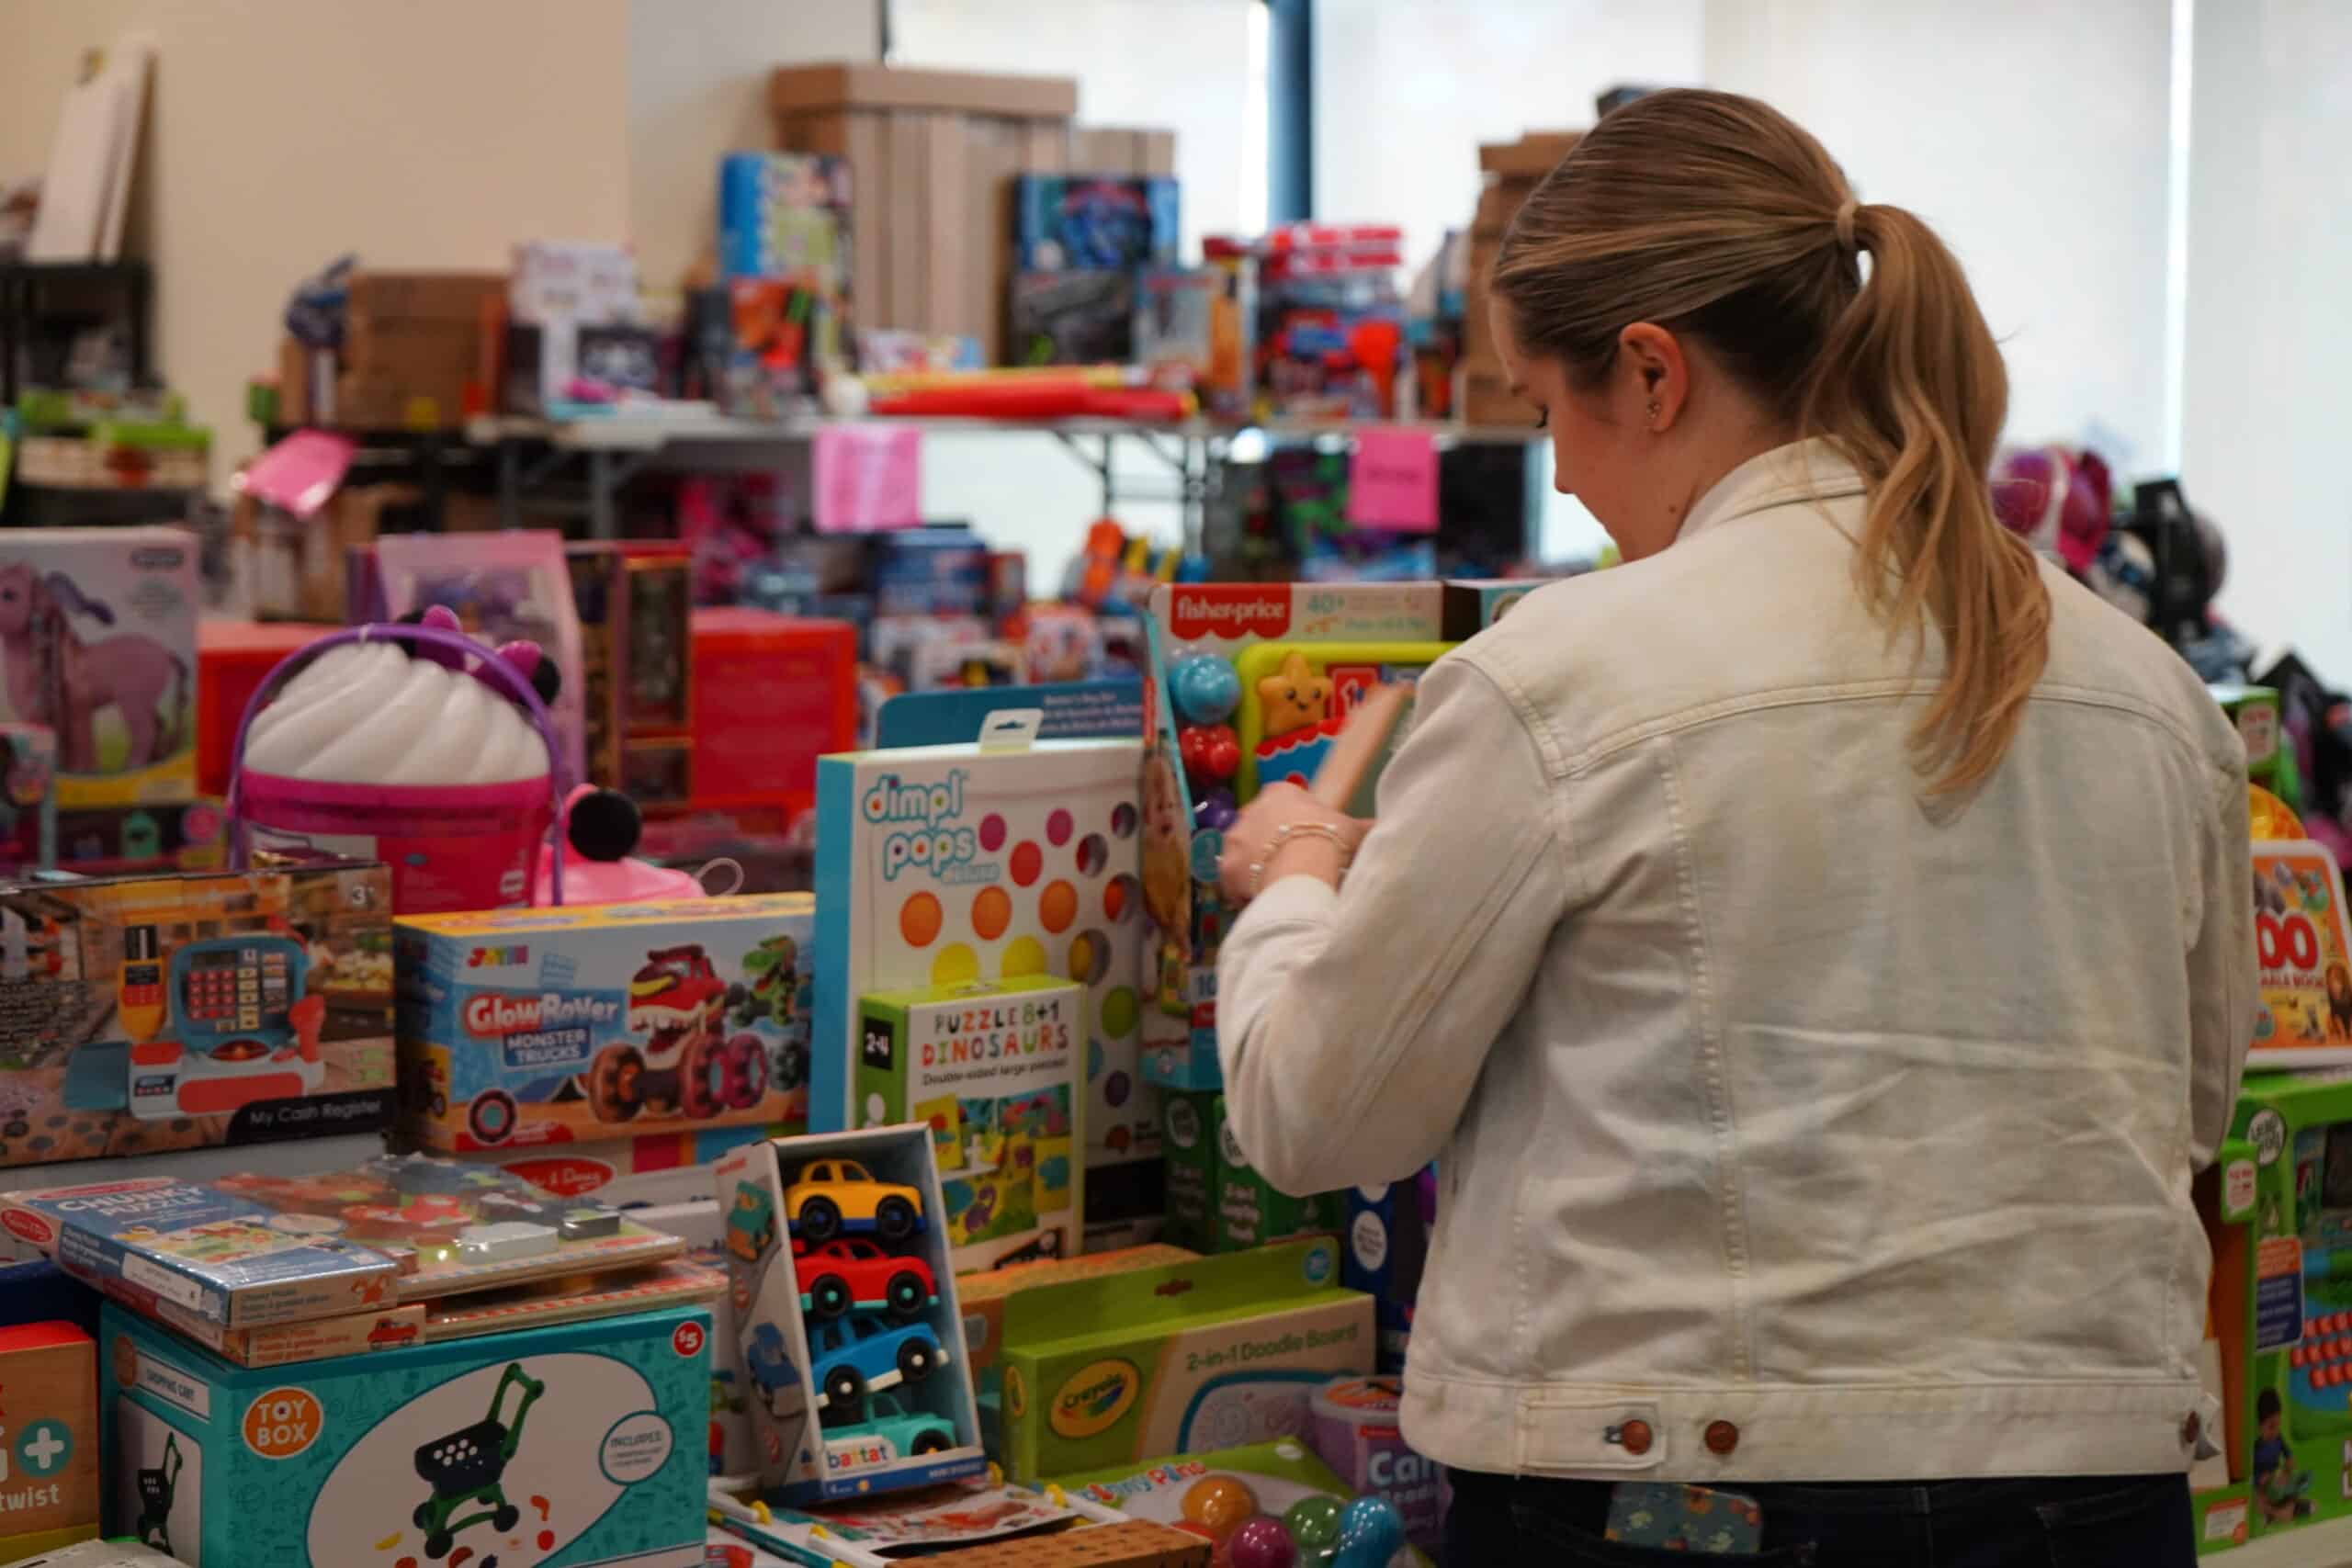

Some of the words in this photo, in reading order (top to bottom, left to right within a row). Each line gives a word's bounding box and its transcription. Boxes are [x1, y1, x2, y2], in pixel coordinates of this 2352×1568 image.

[864, 769, 963, 826] dimpl
[884, 828, 975, 882] pops
[933, 1008, 1017, 1034] PUZZLE
[506, 1028, 587, 1051] MONSTER
[922, 1023, 1069, 1067] DINOSAURS
[515, 1043, 581, 1064] TRUCKS
[257, 1399, 308, 1423] TOY
[256, 1424, 308, 1448] BOX
[0, 1483, 61, 1512] twist
